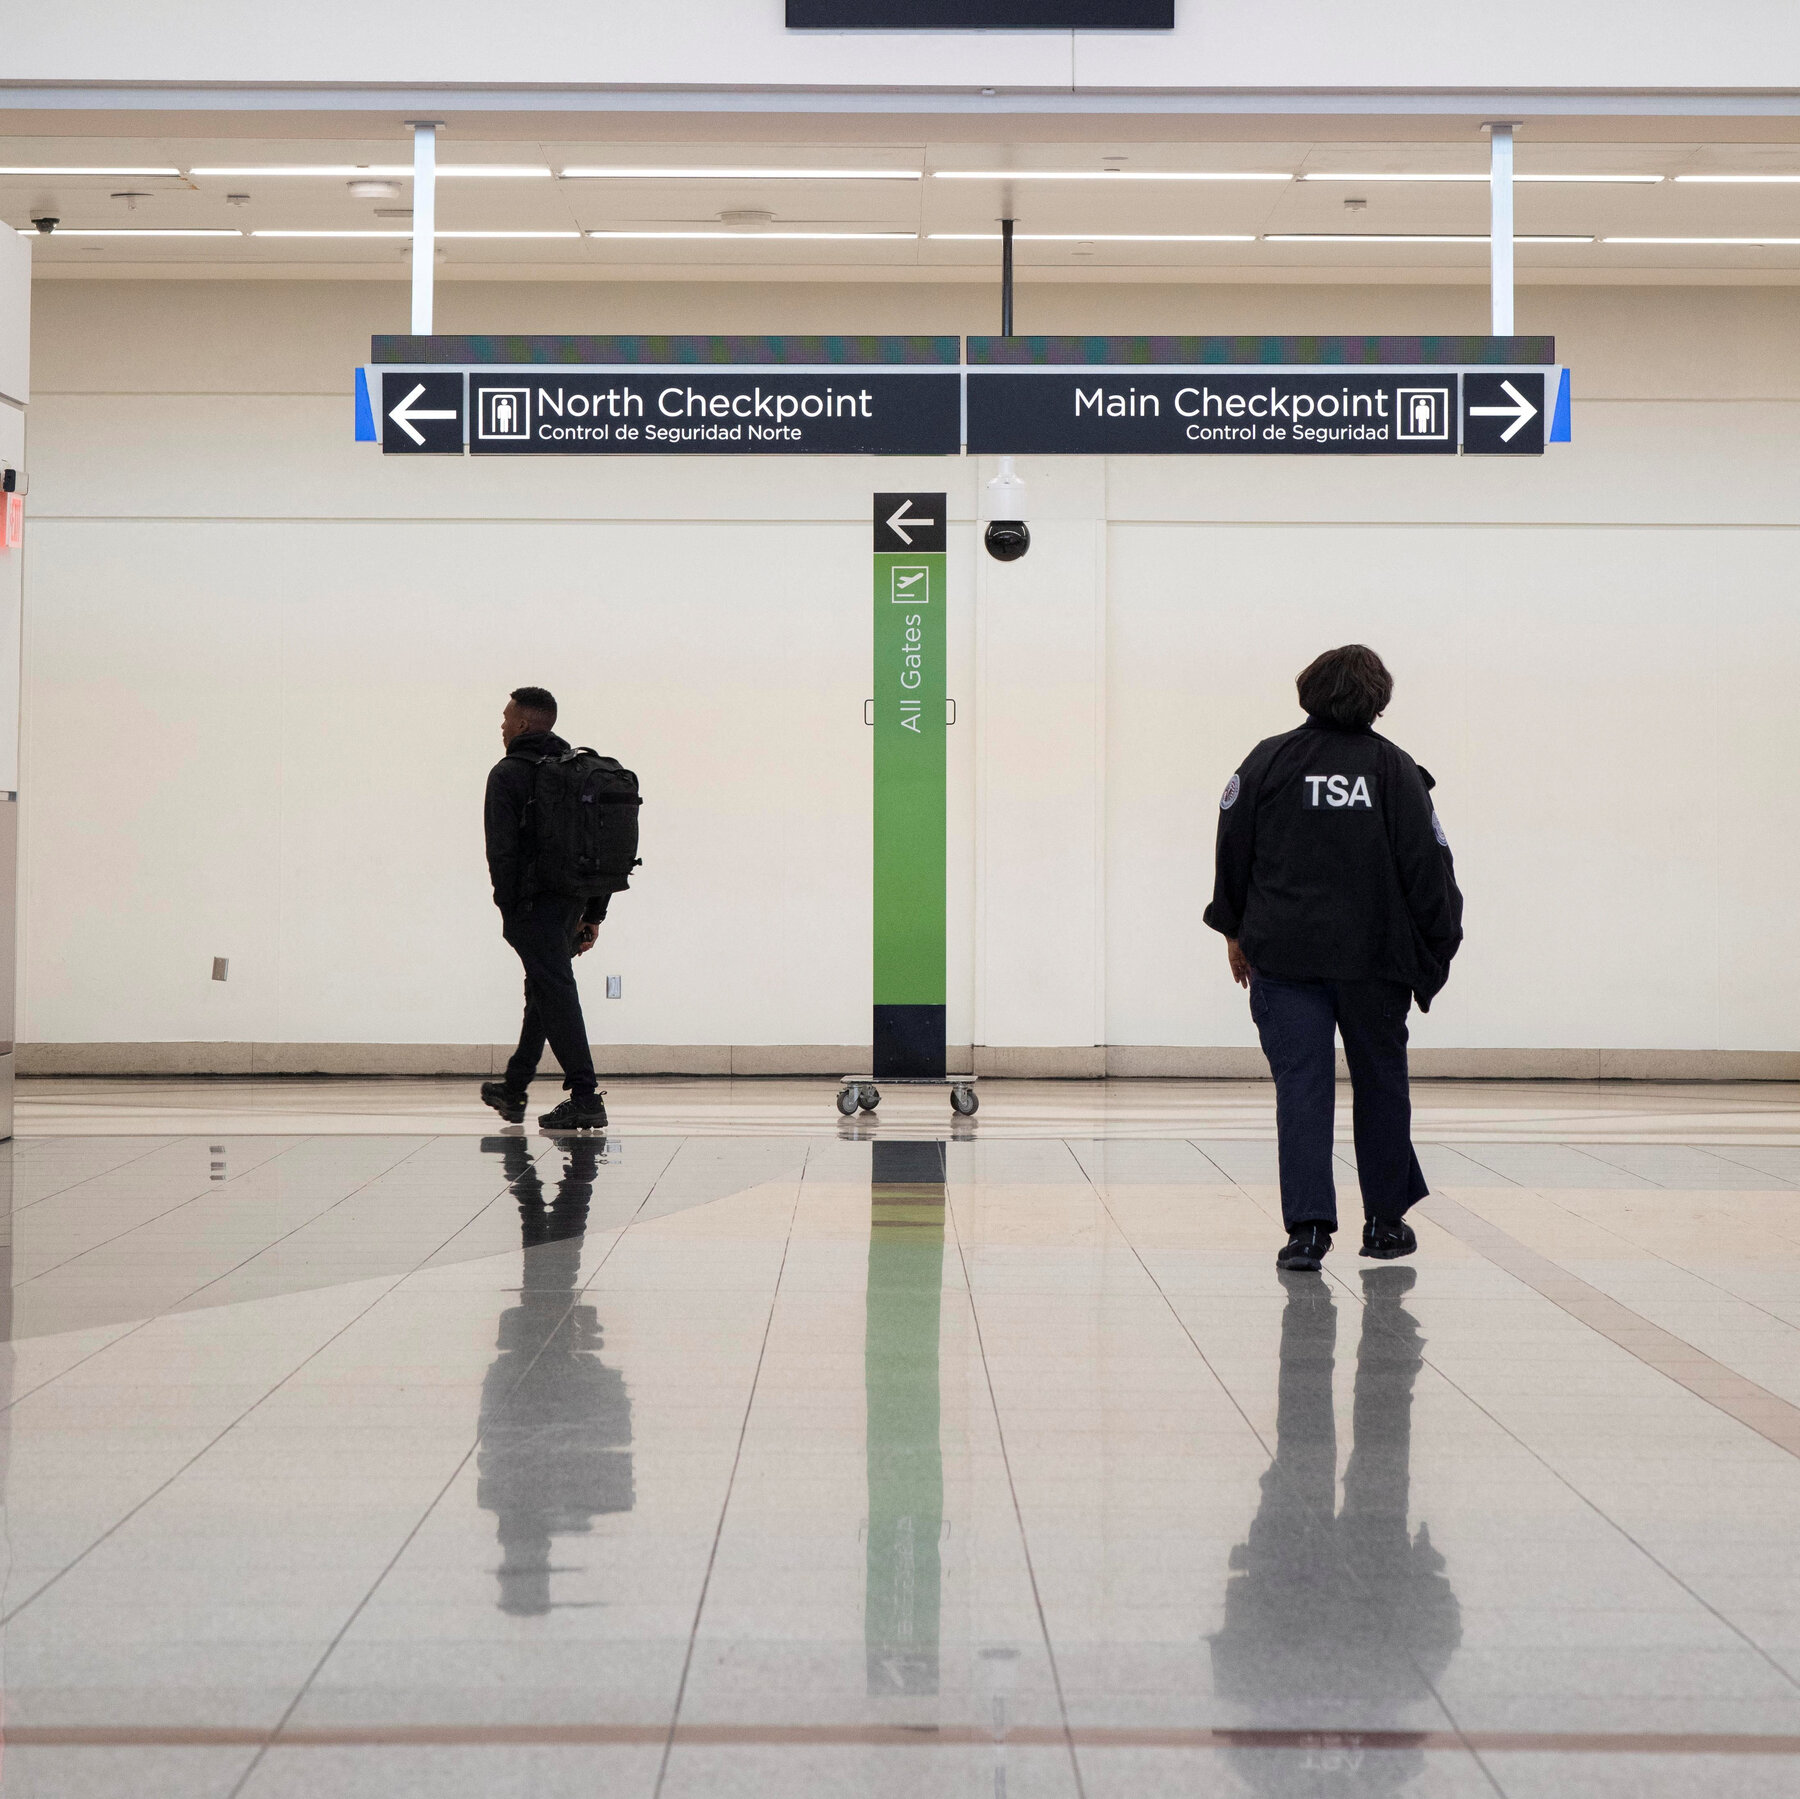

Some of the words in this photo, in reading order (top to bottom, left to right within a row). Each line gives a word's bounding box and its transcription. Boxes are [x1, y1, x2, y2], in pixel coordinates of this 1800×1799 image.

[538, 386, 644, 418] North
[657, 386, 873, 424] Checkpoint
[1075, 386, 1160, 418] Main
[1174, 386, 1389, 424] Checkpoint
[538, 423, 609, 441] Control
[614, 423, 640, 441] de
[644, 423, 742, 444] Seguridad
[748, 423, 802, 441] Norte
[1185, 423, 1256, 441] Control
[1262, 423, 1287, 441] de
[1292, 423, 1389, 444] Seguridad
[900, 614, 922, 690] Gates
[900, 700, 921, 734] All
[1304, 774, 1373, 808] TSA
